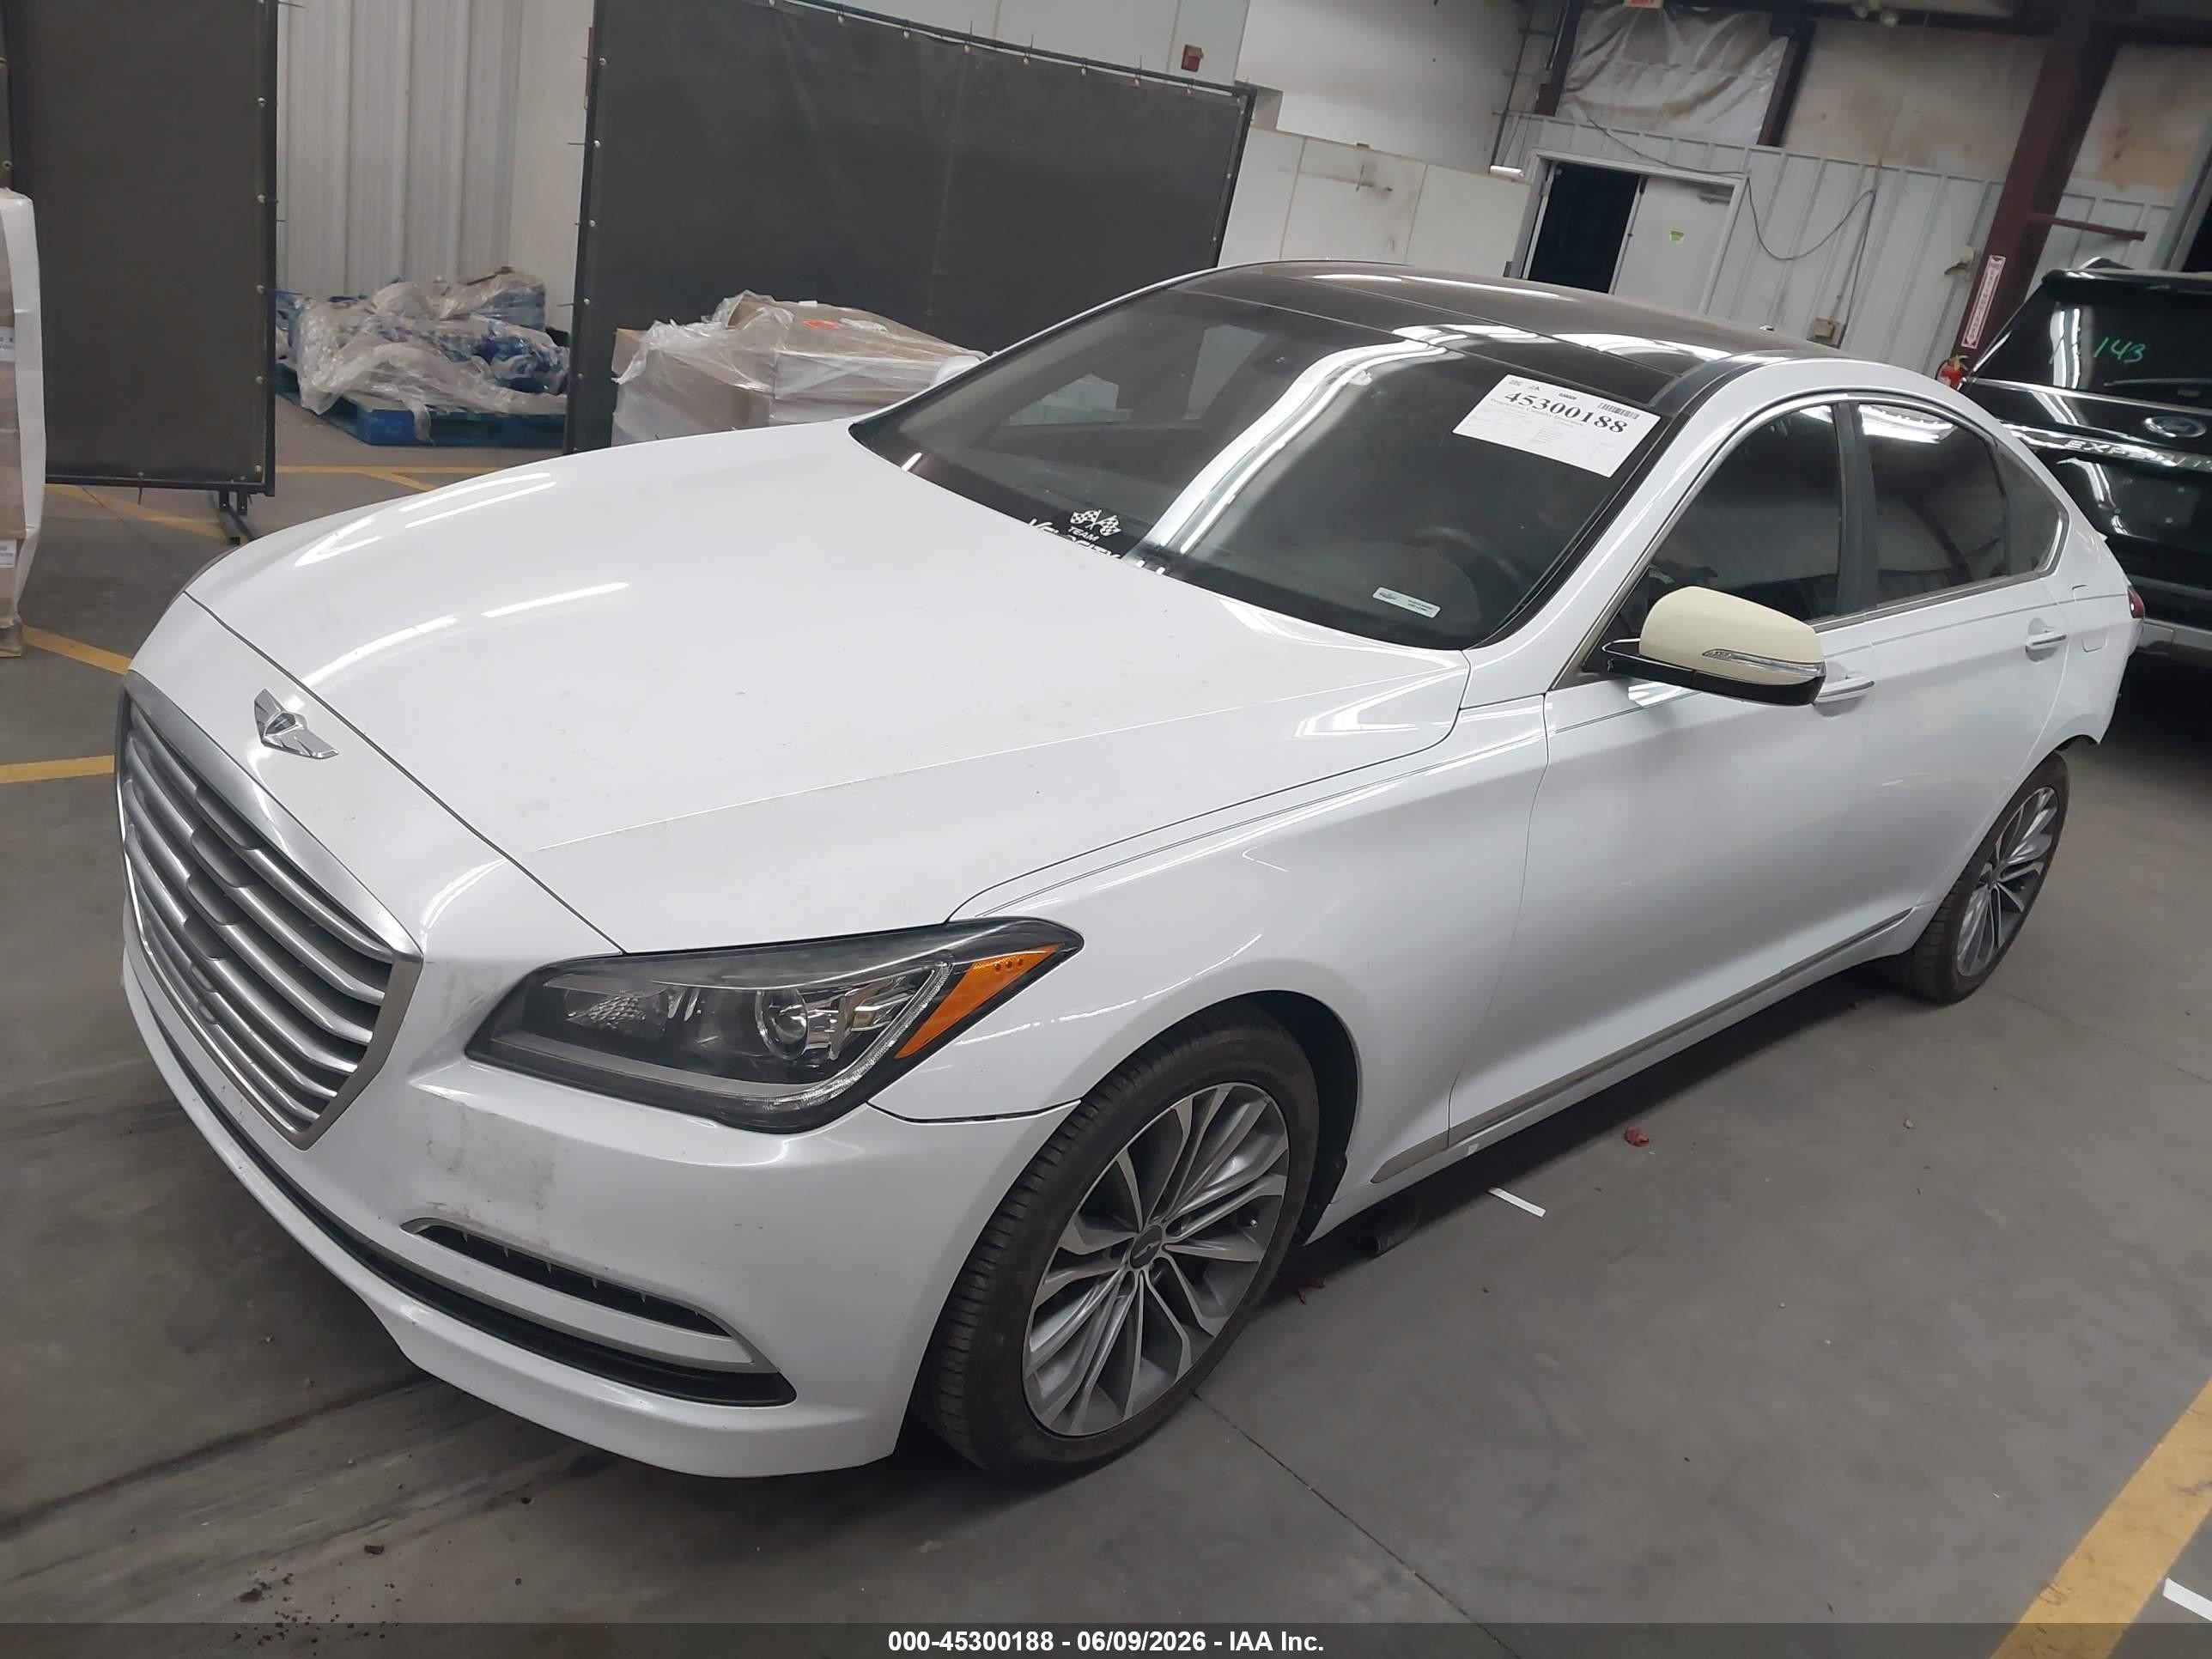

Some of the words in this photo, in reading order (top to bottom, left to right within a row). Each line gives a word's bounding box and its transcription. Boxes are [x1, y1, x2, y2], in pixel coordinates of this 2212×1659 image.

[2094, 336, 2147, 363] 143
[1504, 392, 1628, 434] 45300188
[1067, 526, 1100, 542] TEAM
